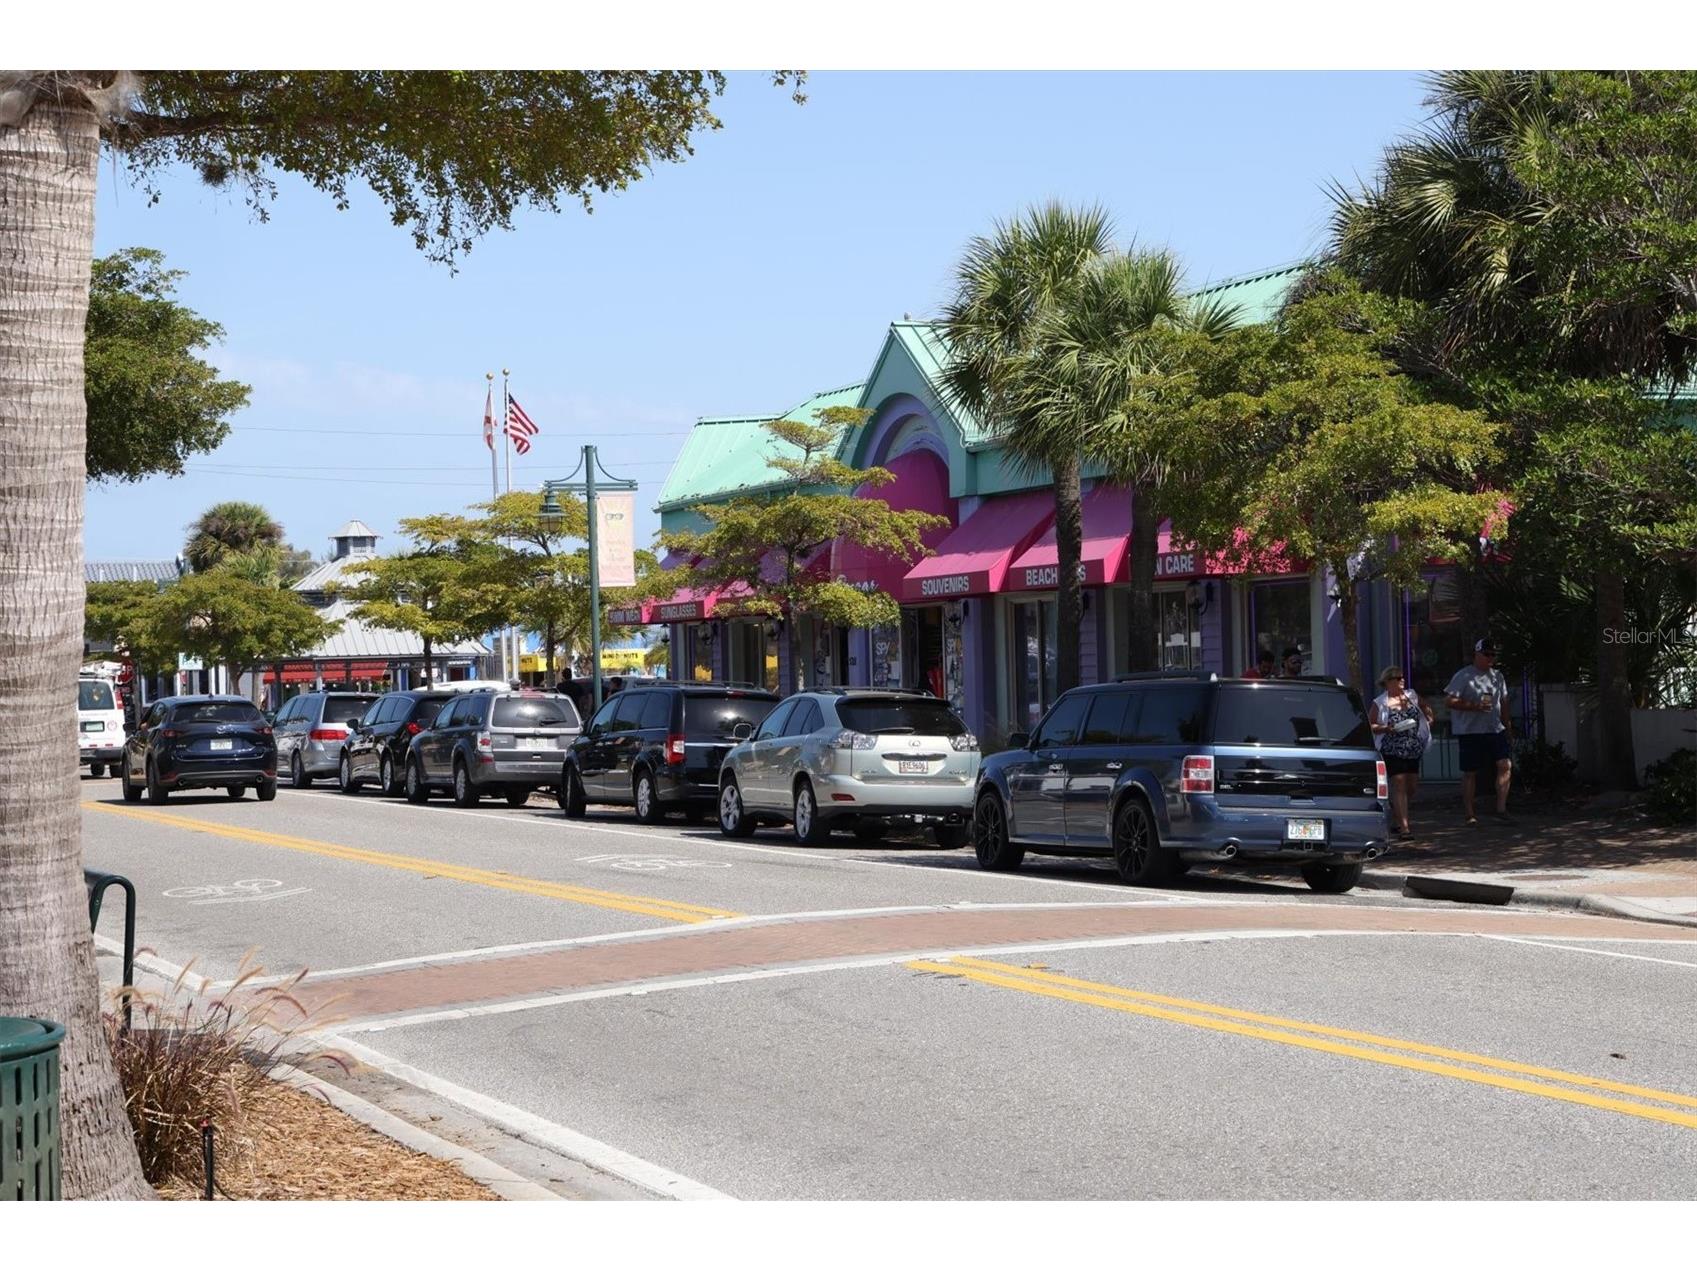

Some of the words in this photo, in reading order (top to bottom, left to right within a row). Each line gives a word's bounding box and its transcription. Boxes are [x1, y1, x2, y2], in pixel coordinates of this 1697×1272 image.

[1165, 554, 1194, 574] CARE
[1026, 567, 1058, 585] BEACH
[922, 576, 969, 595] SOUVENIRS
[661, 604, 696, 619] SUNGLASSES
